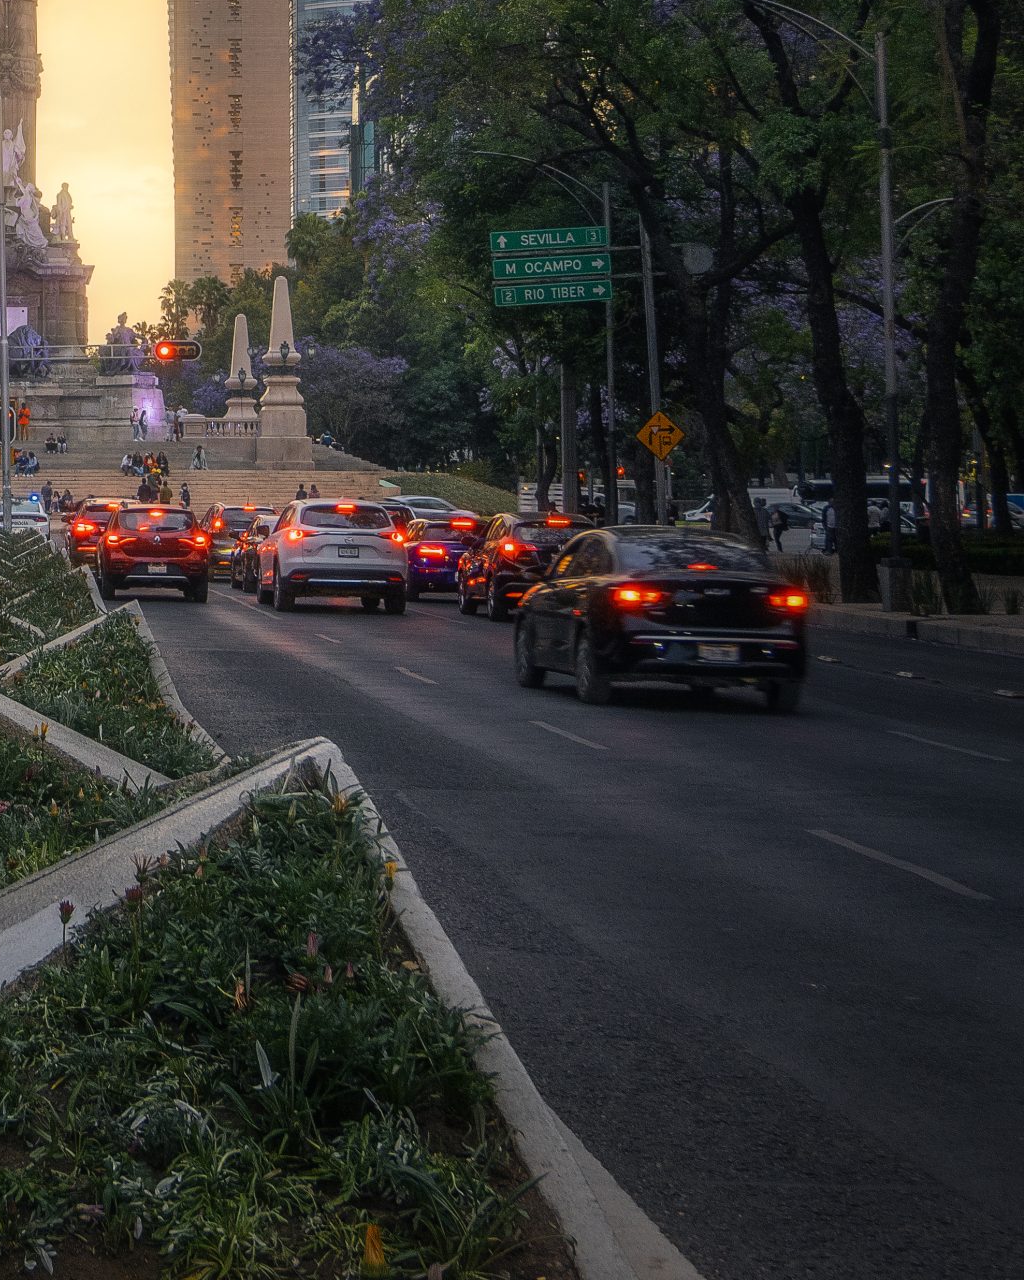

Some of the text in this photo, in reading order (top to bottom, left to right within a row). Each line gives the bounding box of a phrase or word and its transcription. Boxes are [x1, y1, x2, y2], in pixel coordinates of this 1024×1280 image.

[520, 231, 597, 246] SEVILLA 3
[506, 259, 582, 274] M OCAMPO
[524, 288, 545, 300] RIO
[550, 286, 585, 299] TIBER
